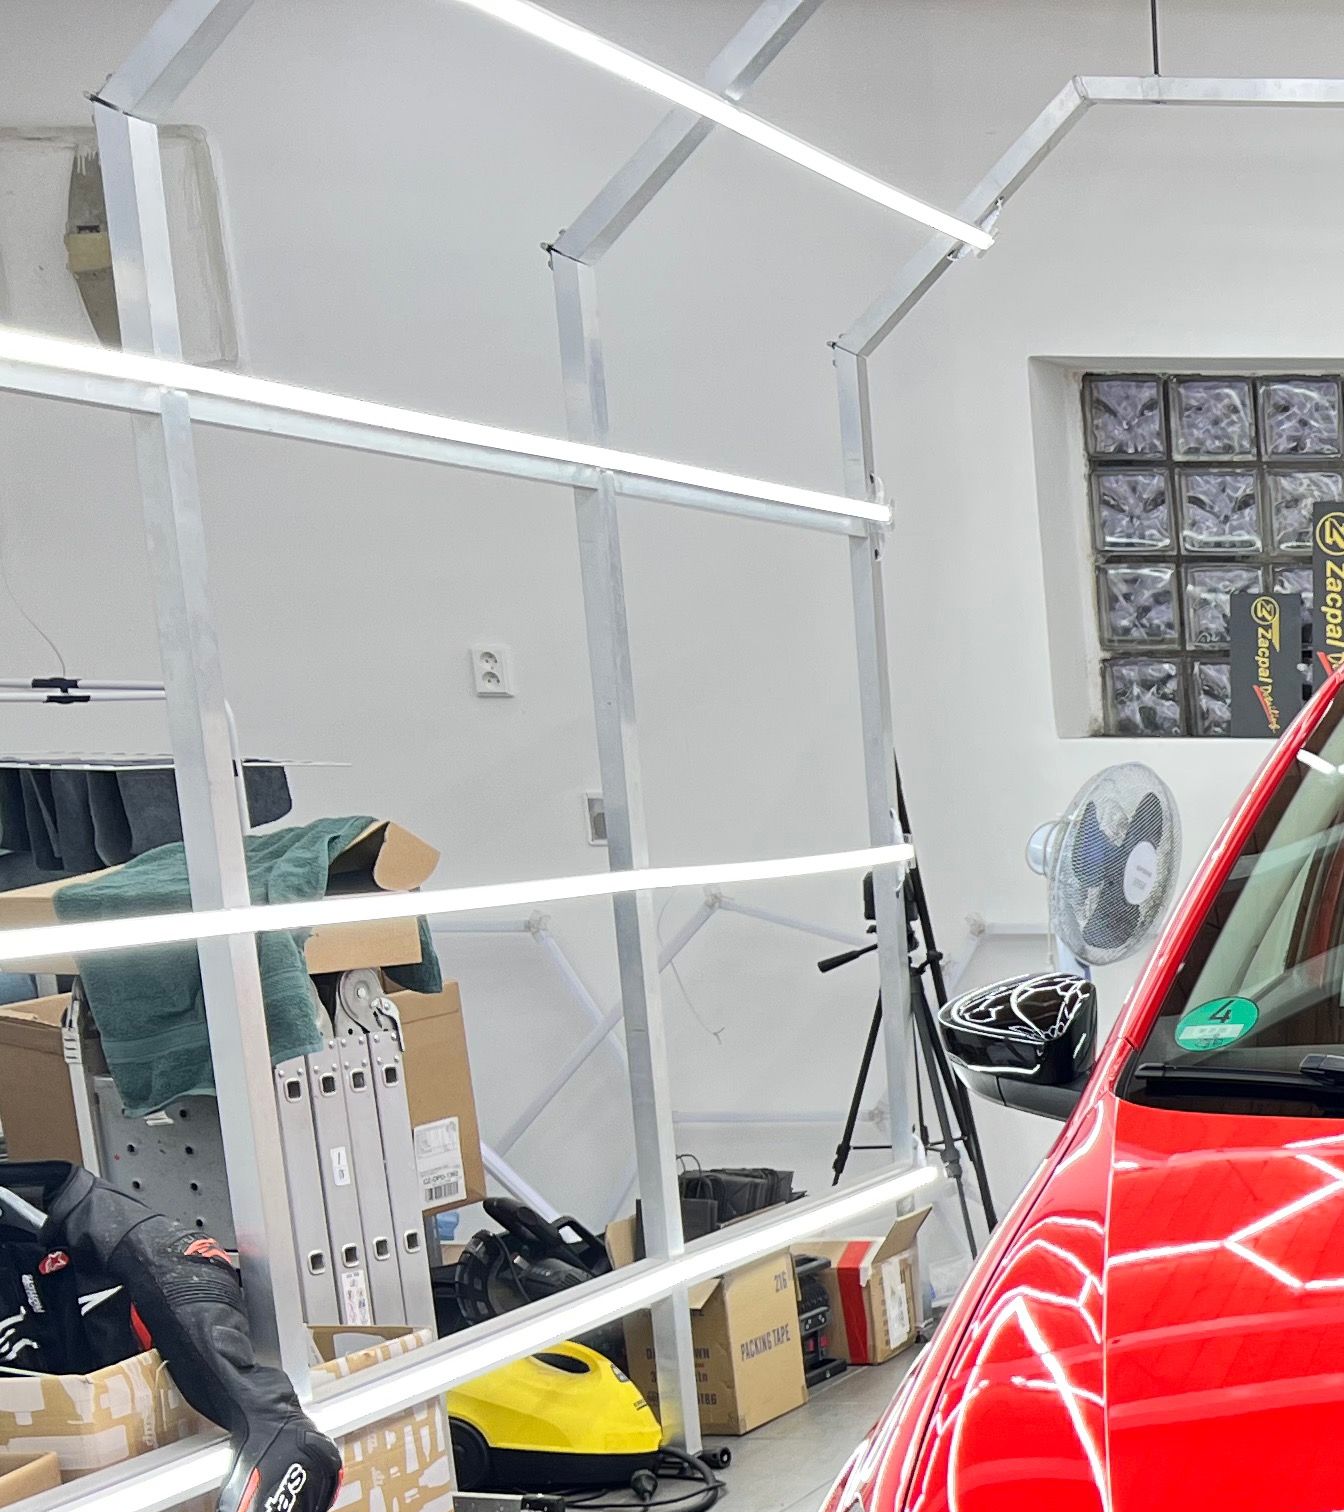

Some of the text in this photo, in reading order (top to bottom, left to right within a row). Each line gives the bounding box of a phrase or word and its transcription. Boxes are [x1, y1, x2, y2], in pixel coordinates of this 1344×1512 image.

[1254, 626, 1273, 686] Zacpal
[1208, 1000, 1235, 1023] 4
[774, 1271, 788, 1293] 216
[740, 1330, 773, 1361] PACKING
[773, 1323, 791, 1346] TAPE
